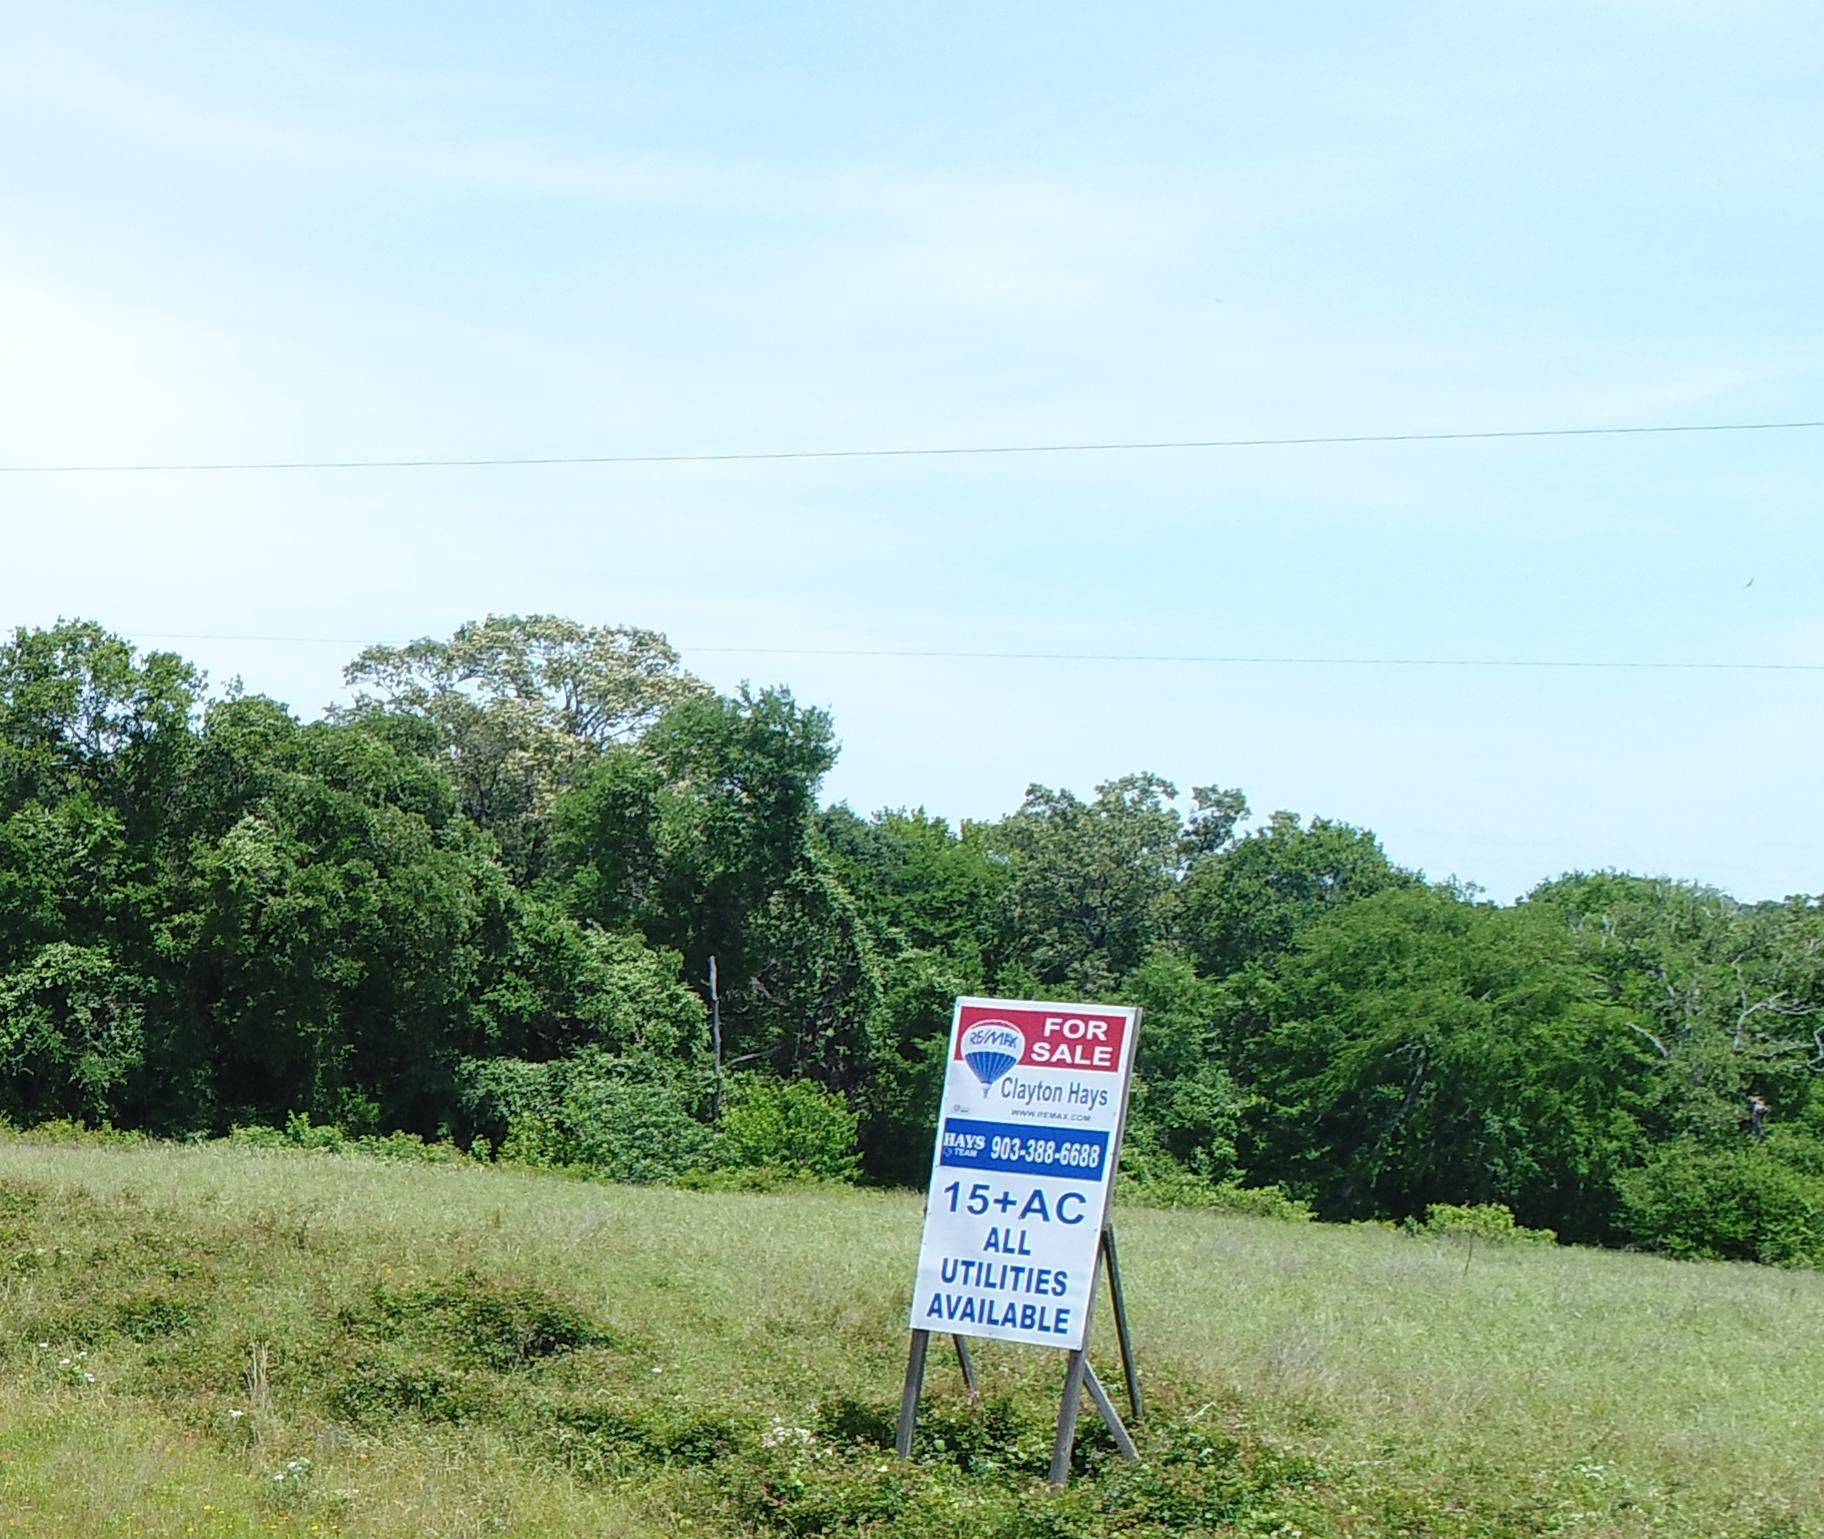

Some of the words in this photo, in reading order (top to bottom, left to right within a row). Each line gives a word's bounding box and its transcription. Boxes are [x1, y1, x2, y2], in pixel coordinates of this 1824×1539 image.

[969, 1029, 1019, 1049] RE/MAX
[1043, 1017, 1108, 1041] FOR
[1030, 1042, 1113, 1066] SALE
[1000, 1077, 1063, 1105] Clayton
[1068, 1082, 1108, 1110] Hays
[943, 1132, 986, 1150] HAYS
[954, 1147, 978, 1158] TEAM
[990, 1135, 1100, 1168] 903-388-6688
[943, 1181, 1087, 1225] 15+AC
[982, 1226, 1032, 1256] ALL
[941, 1257, 1069, 1297] UTILITIES
[926, 1292, 1071, 1335] AVAILABLE
